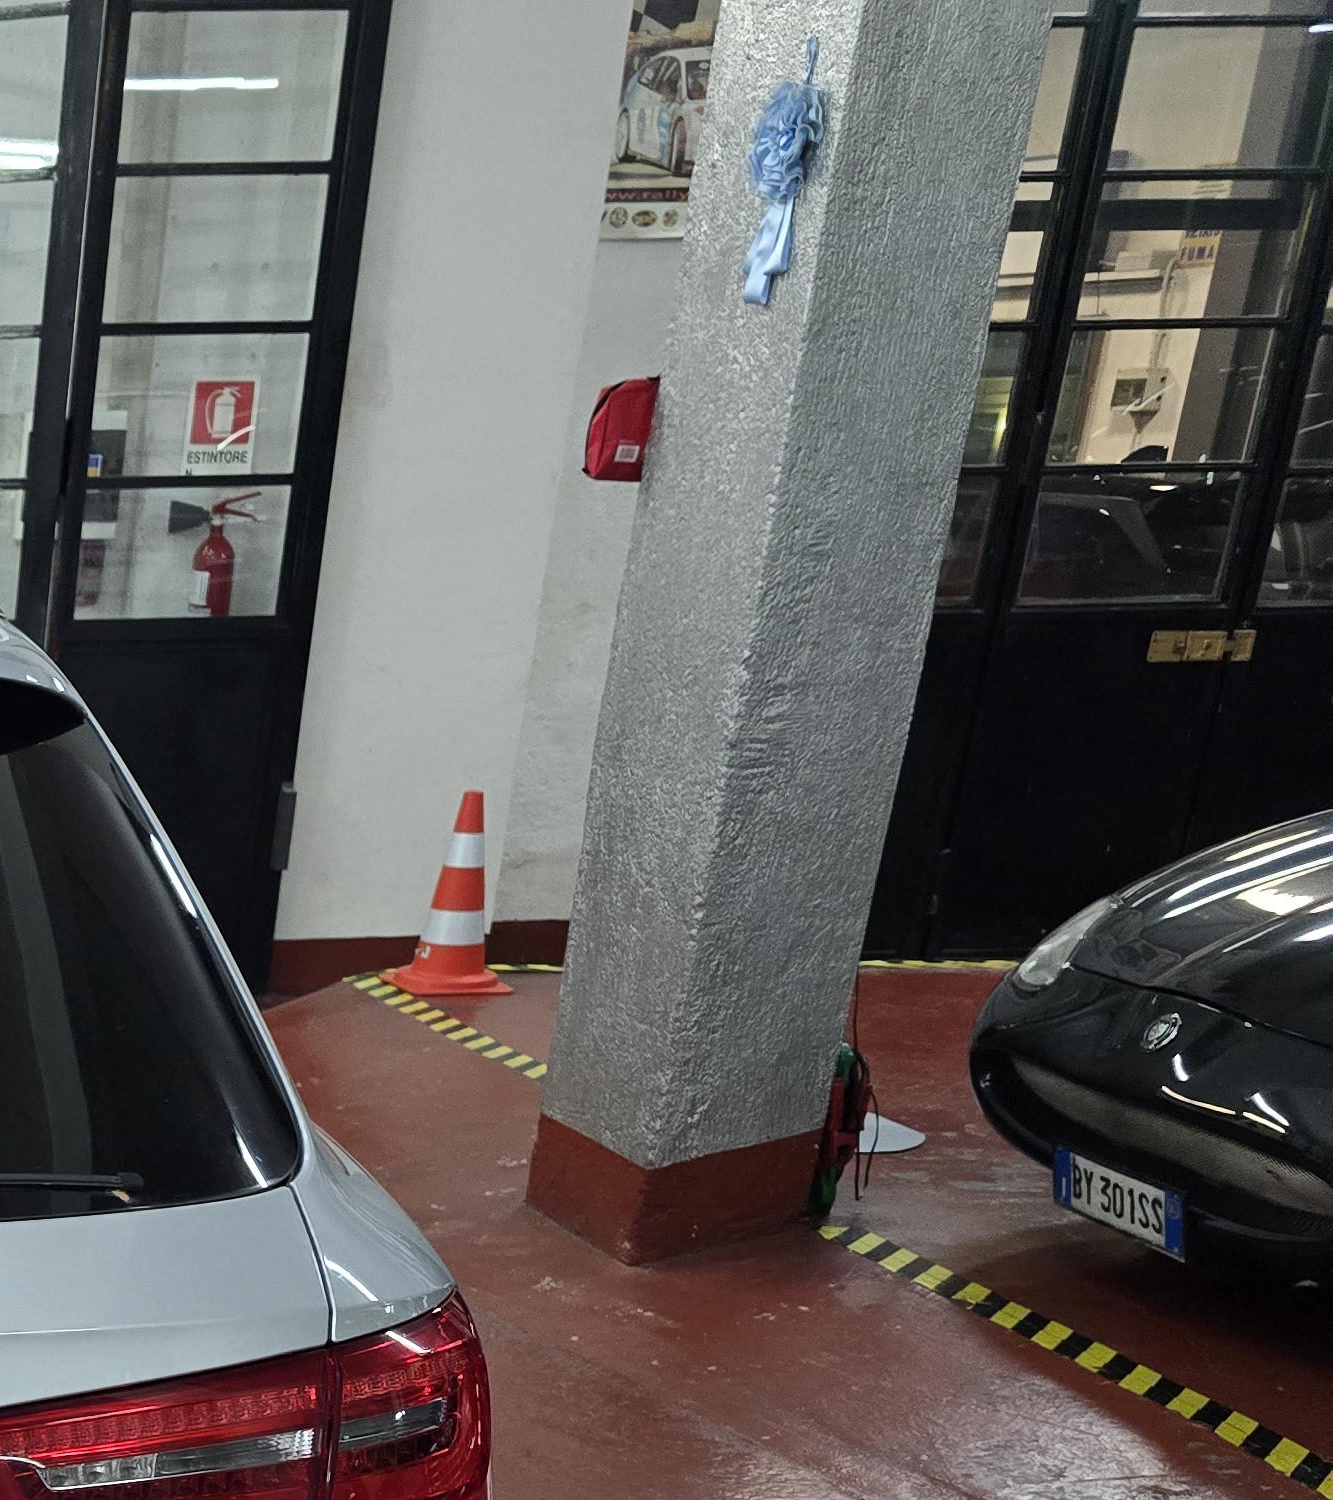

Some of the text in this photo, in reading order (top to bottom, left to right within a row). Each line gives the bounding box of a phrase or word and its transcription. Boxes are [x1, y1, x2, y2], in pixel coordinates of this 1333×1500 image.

[186, 450, 248, 464] ESTINTORE
[1073, 1163, 1093, 1205] BY
[1100, 1175, 1163, 1235] 301SS
